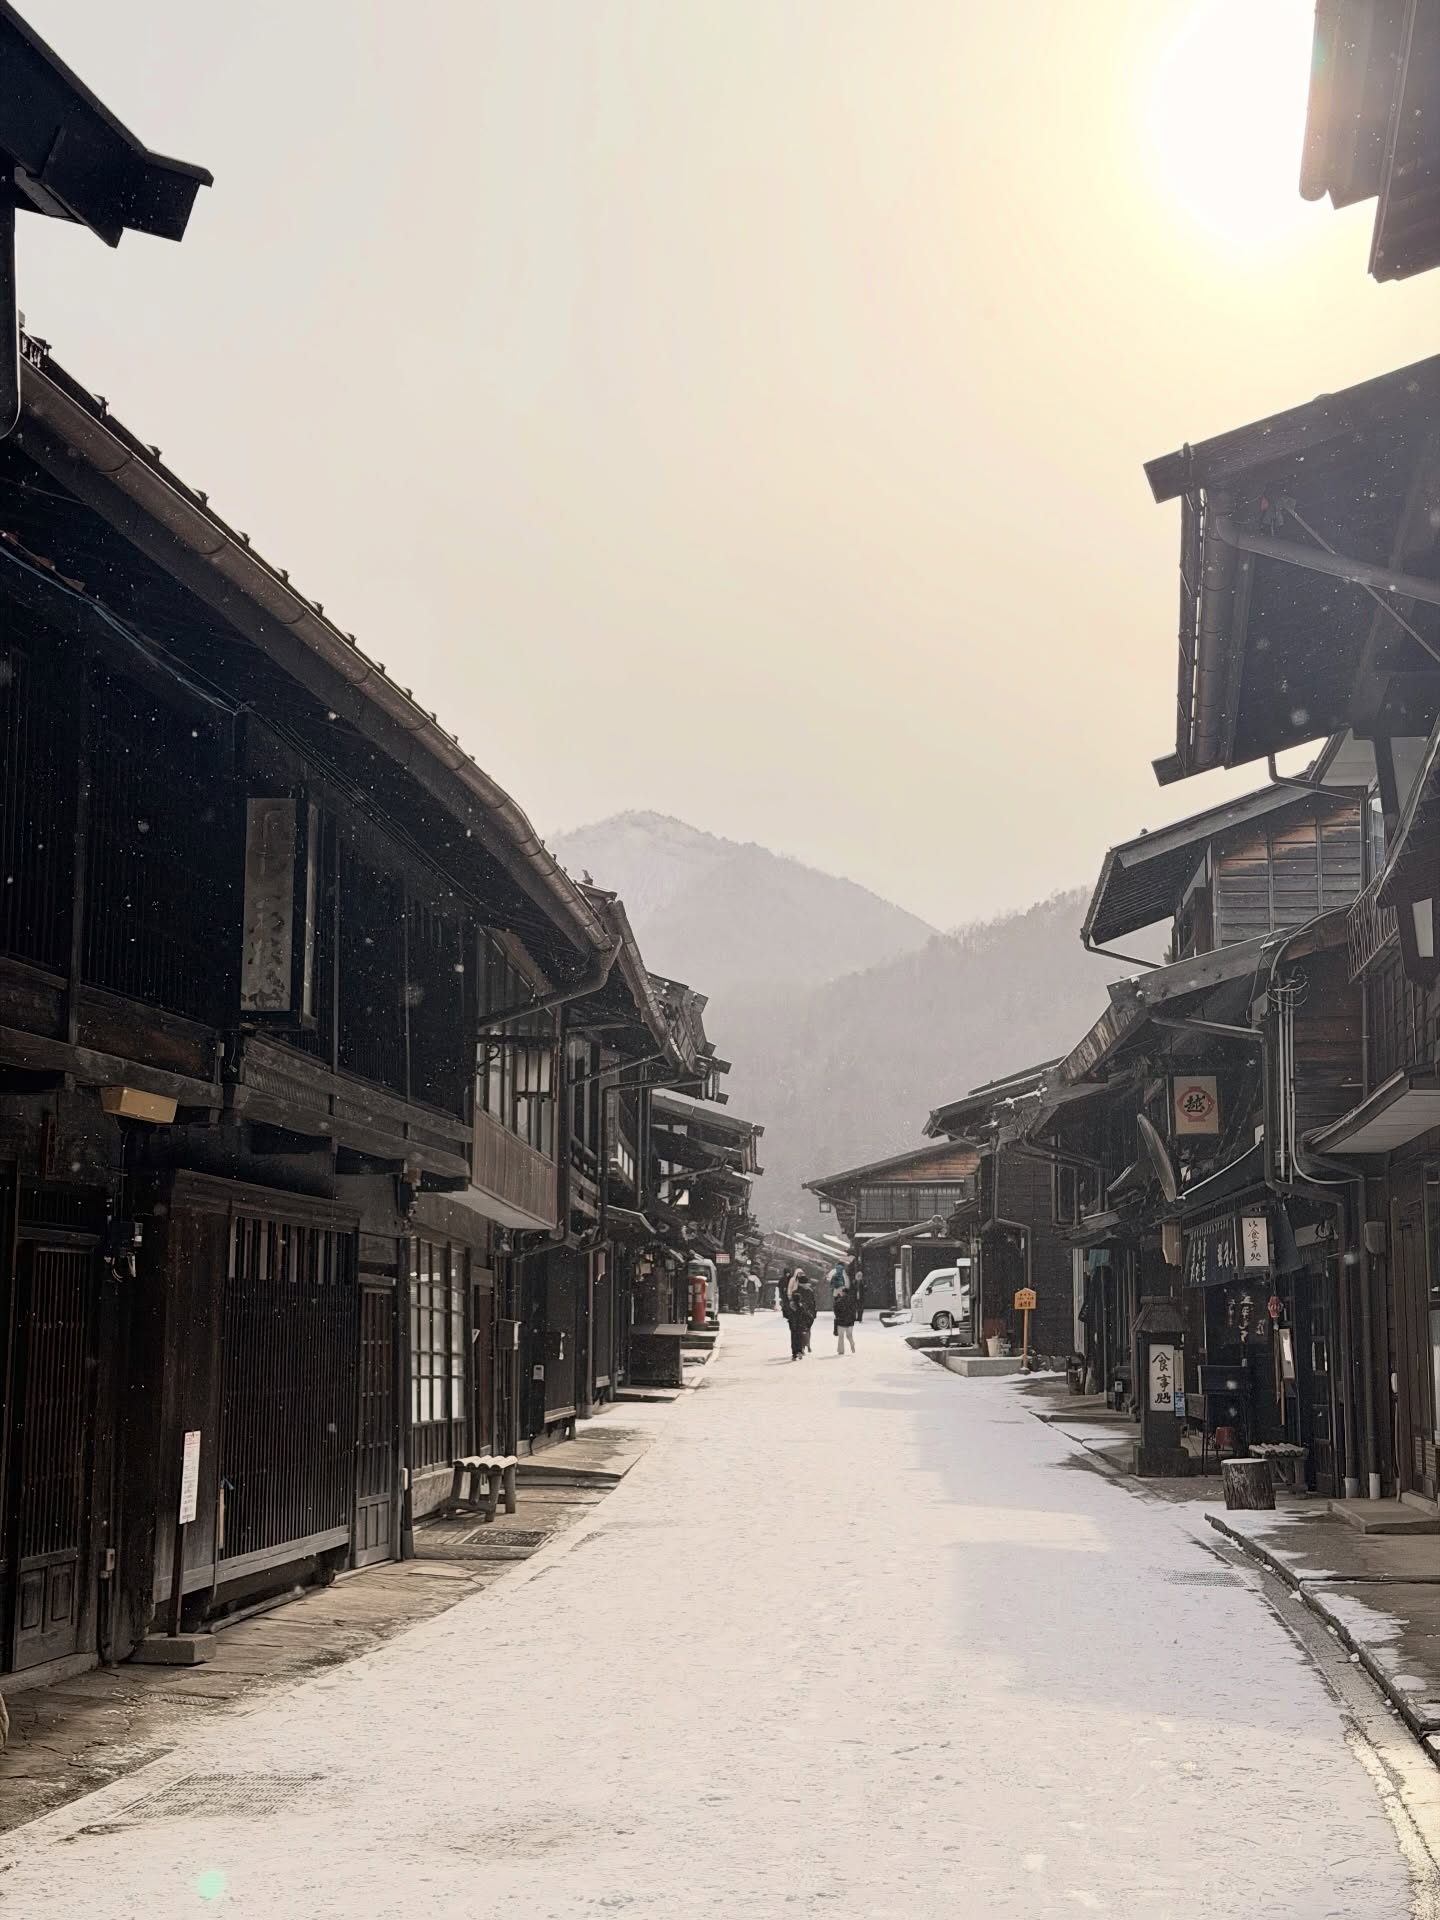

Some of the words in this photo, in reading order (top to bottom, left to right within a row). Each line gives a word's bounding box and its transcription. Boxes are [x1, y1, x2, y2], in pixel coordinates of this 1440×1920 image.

[1184, 1094, 1206, 1112] 越
[1152, 1351, 1172, 1404] 食事処
